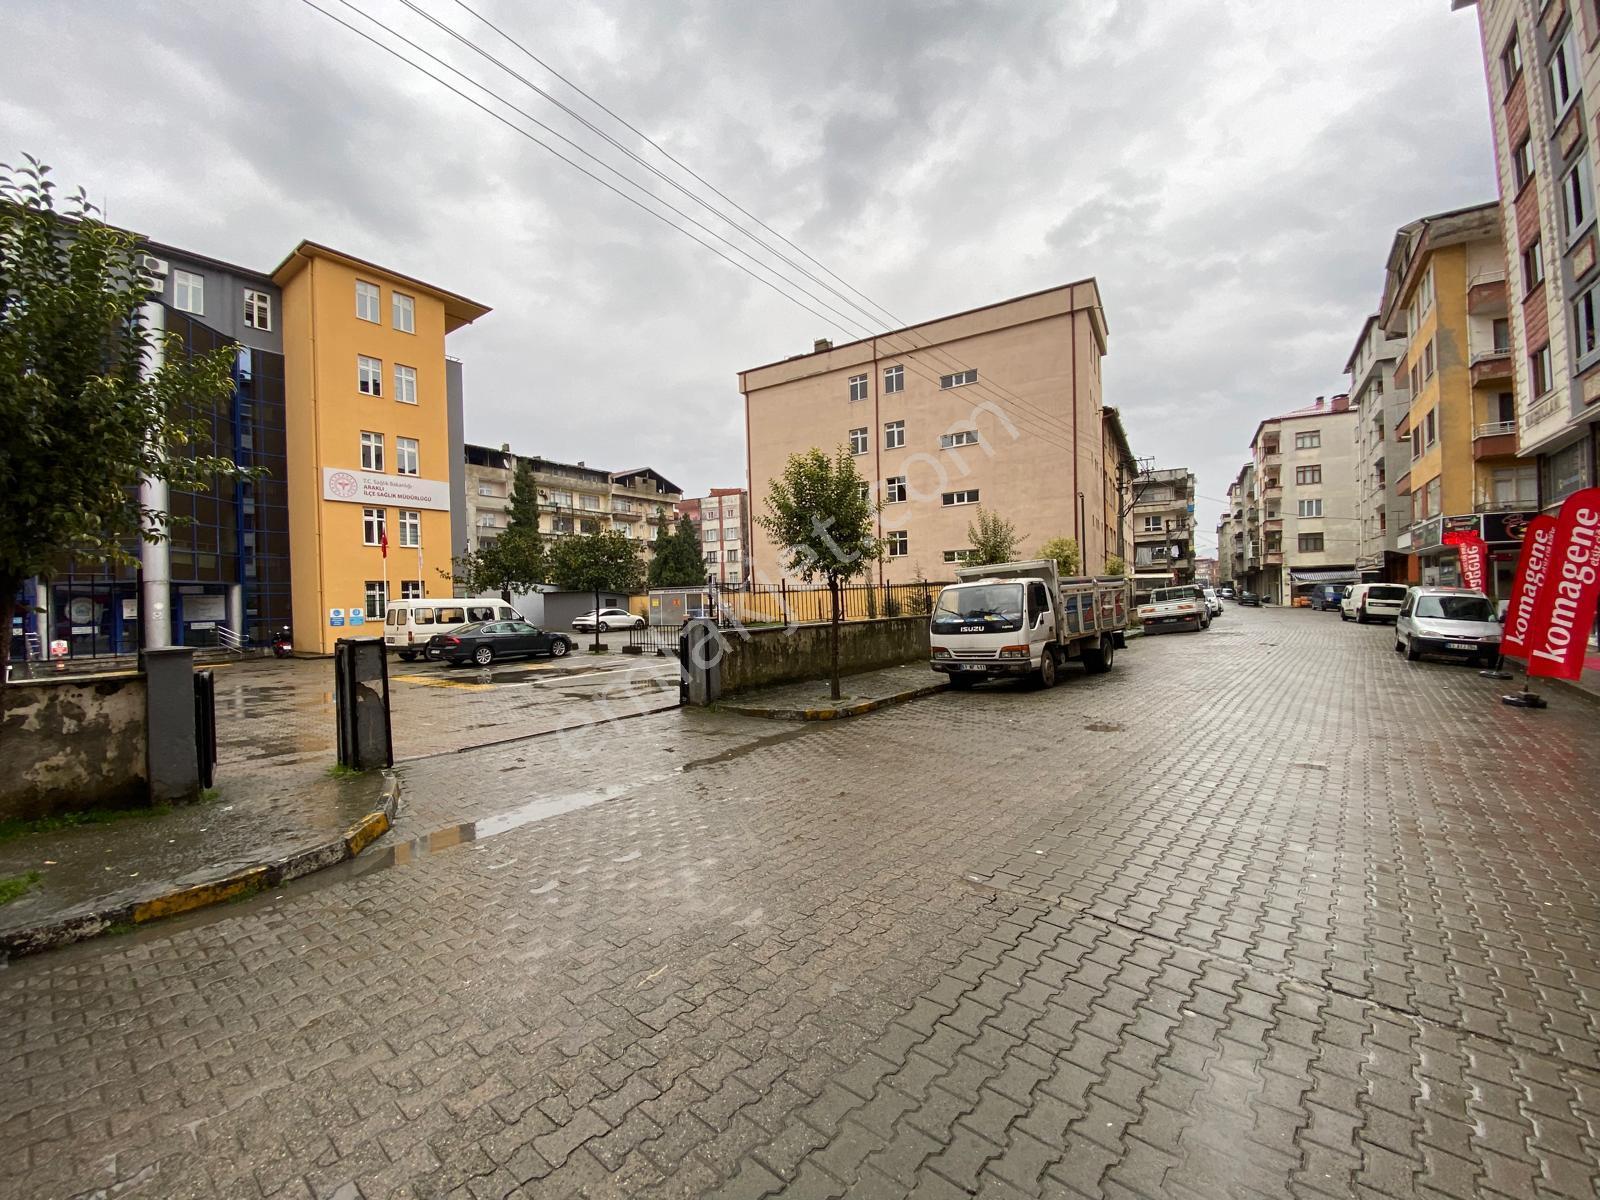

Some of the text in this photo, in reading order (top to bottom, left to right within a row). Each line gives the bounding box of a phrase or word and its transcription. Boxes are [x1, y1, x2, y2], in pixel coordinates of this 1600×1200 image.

[377, 491, 397, 499] SAĞLIK
[397, 493, 432, 502] MÜDÜRLÜĞÜ
[1505, 529, 1548, 646] komagene
[1532, 508, 1599, 663] komagene
[960, 625, 985, 633] ISUZU
